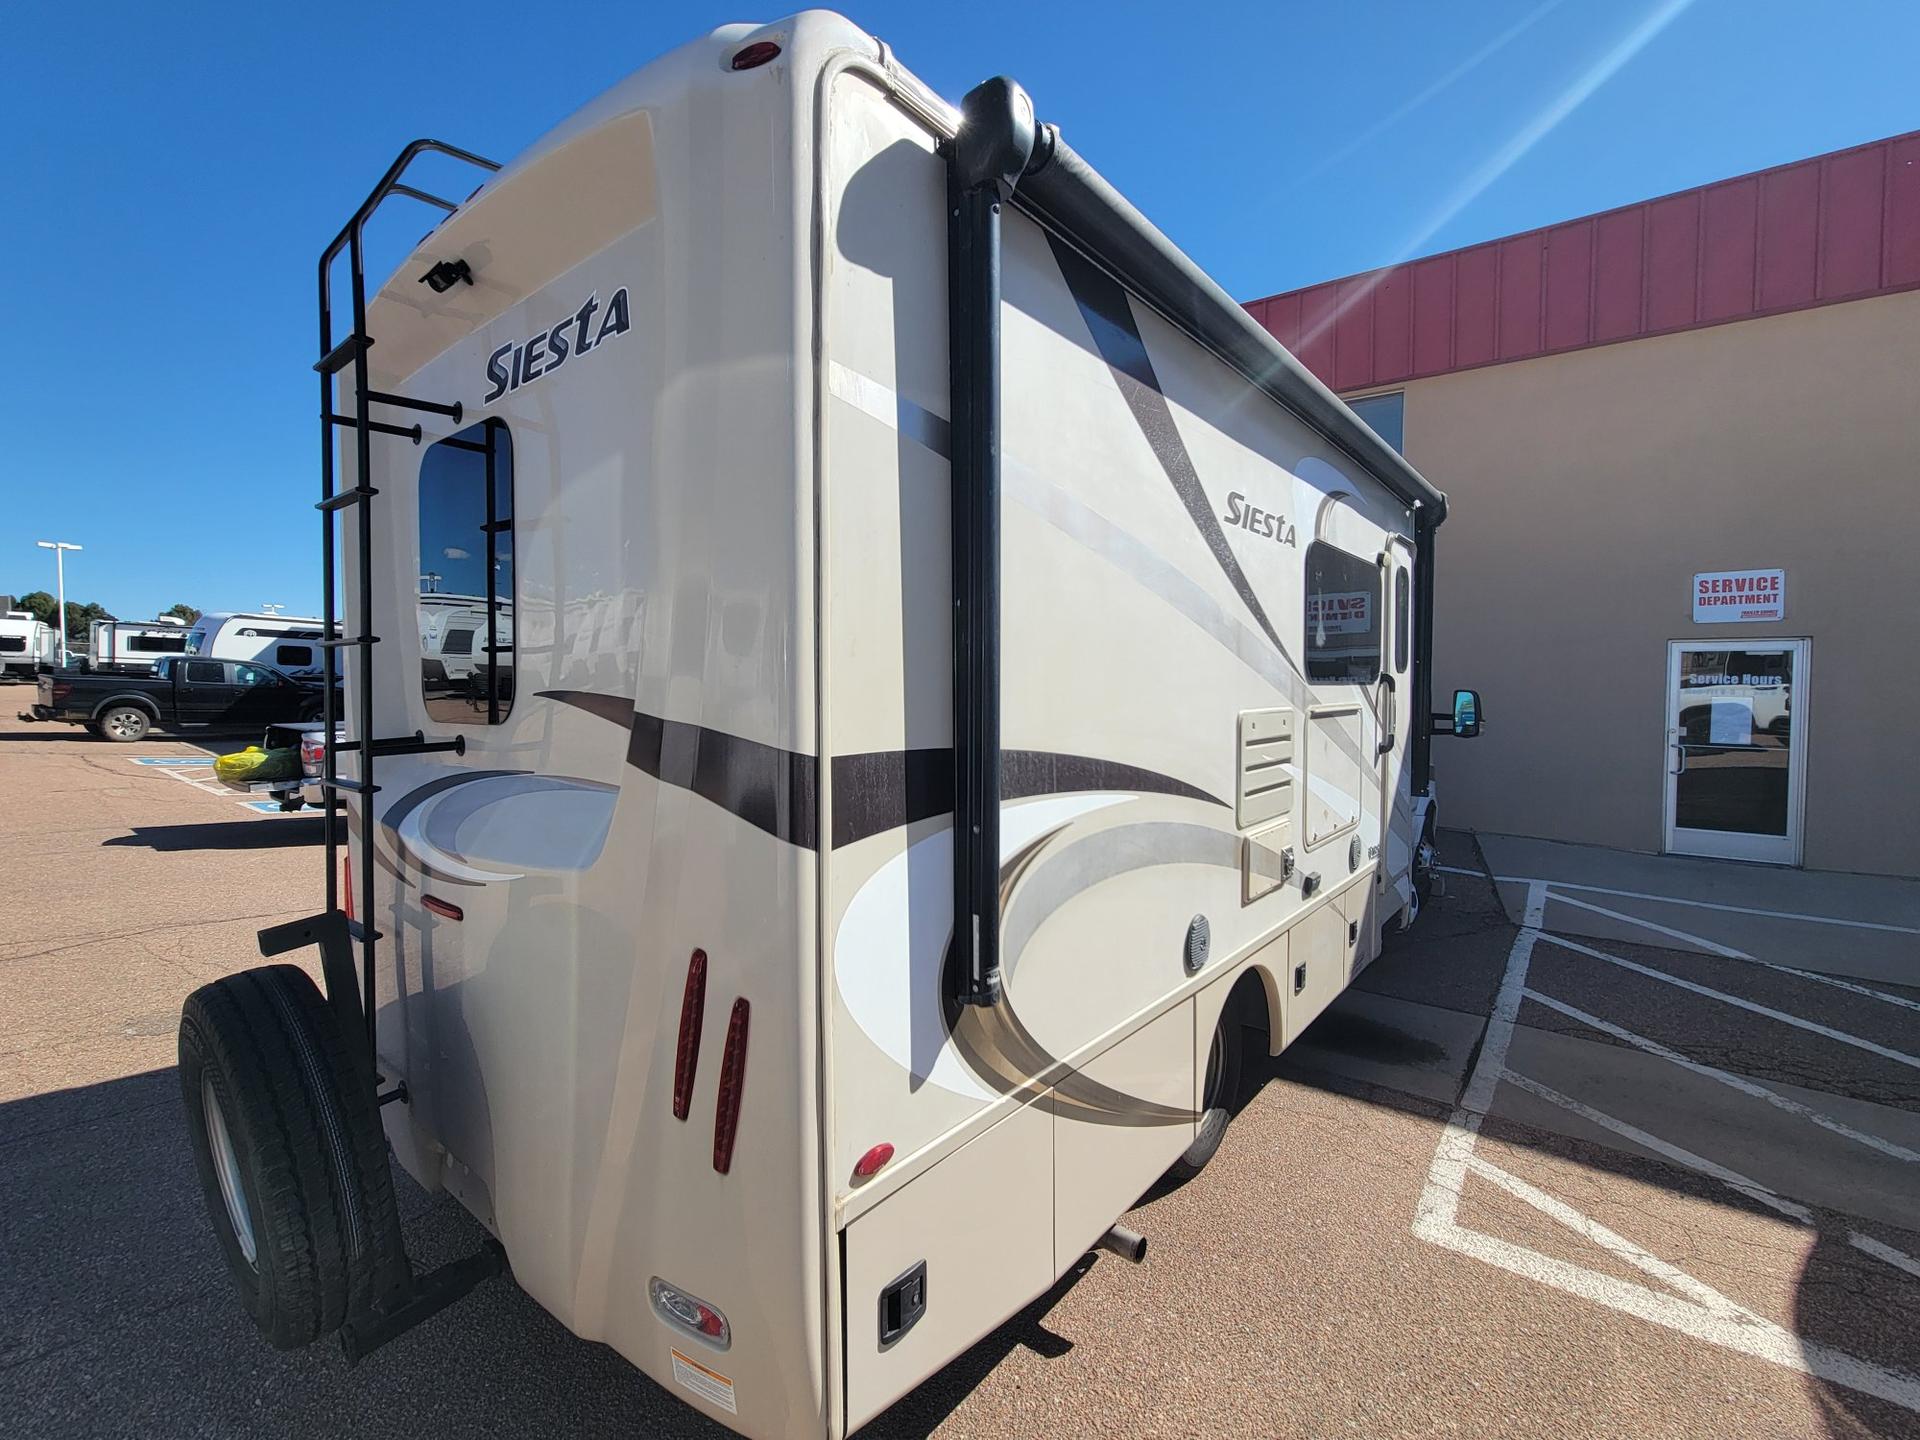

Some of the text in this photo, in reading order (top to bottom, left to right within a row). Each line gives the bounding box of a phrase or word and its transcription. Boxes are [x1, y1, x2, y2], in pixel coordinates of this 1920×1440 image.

[1698, 576, 1779, 594] SERVICE
[1698, 593, 1779, 606] DEPARTMENT
[1689, 673, 1782, 685] Service Hours
